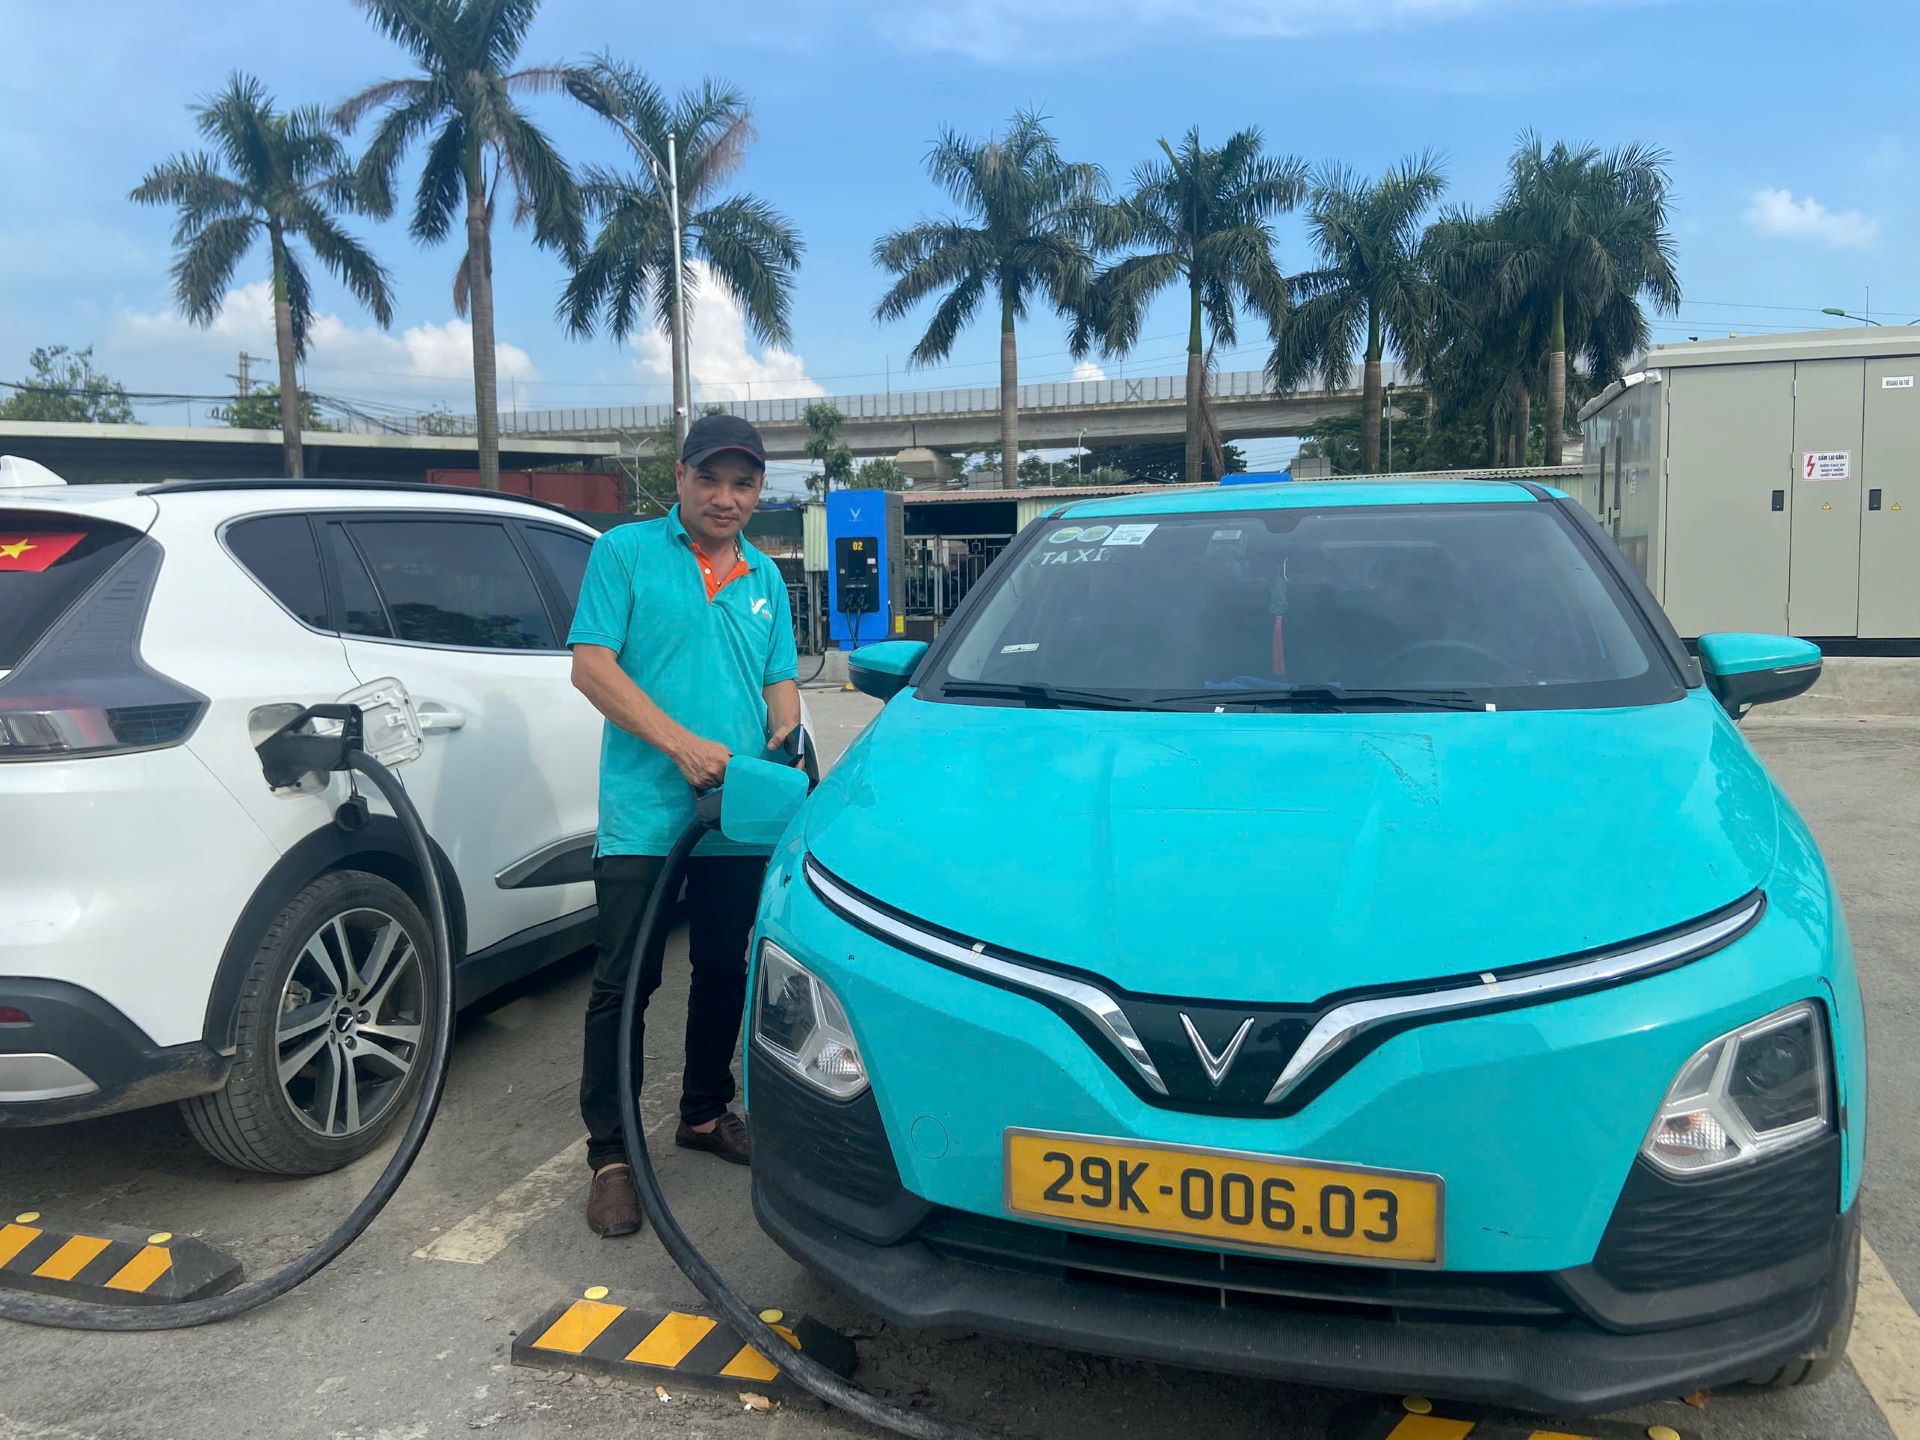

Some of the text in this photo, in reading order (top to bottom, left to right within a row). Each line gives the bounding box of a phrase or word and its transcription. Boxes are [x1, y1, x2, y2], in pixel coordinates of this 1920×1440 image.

[852, 541, 864, 551] 02
[1040, 547, 1107, 566] TAXI
[1042, 1151, 1399, 1243] 29K-006.03
